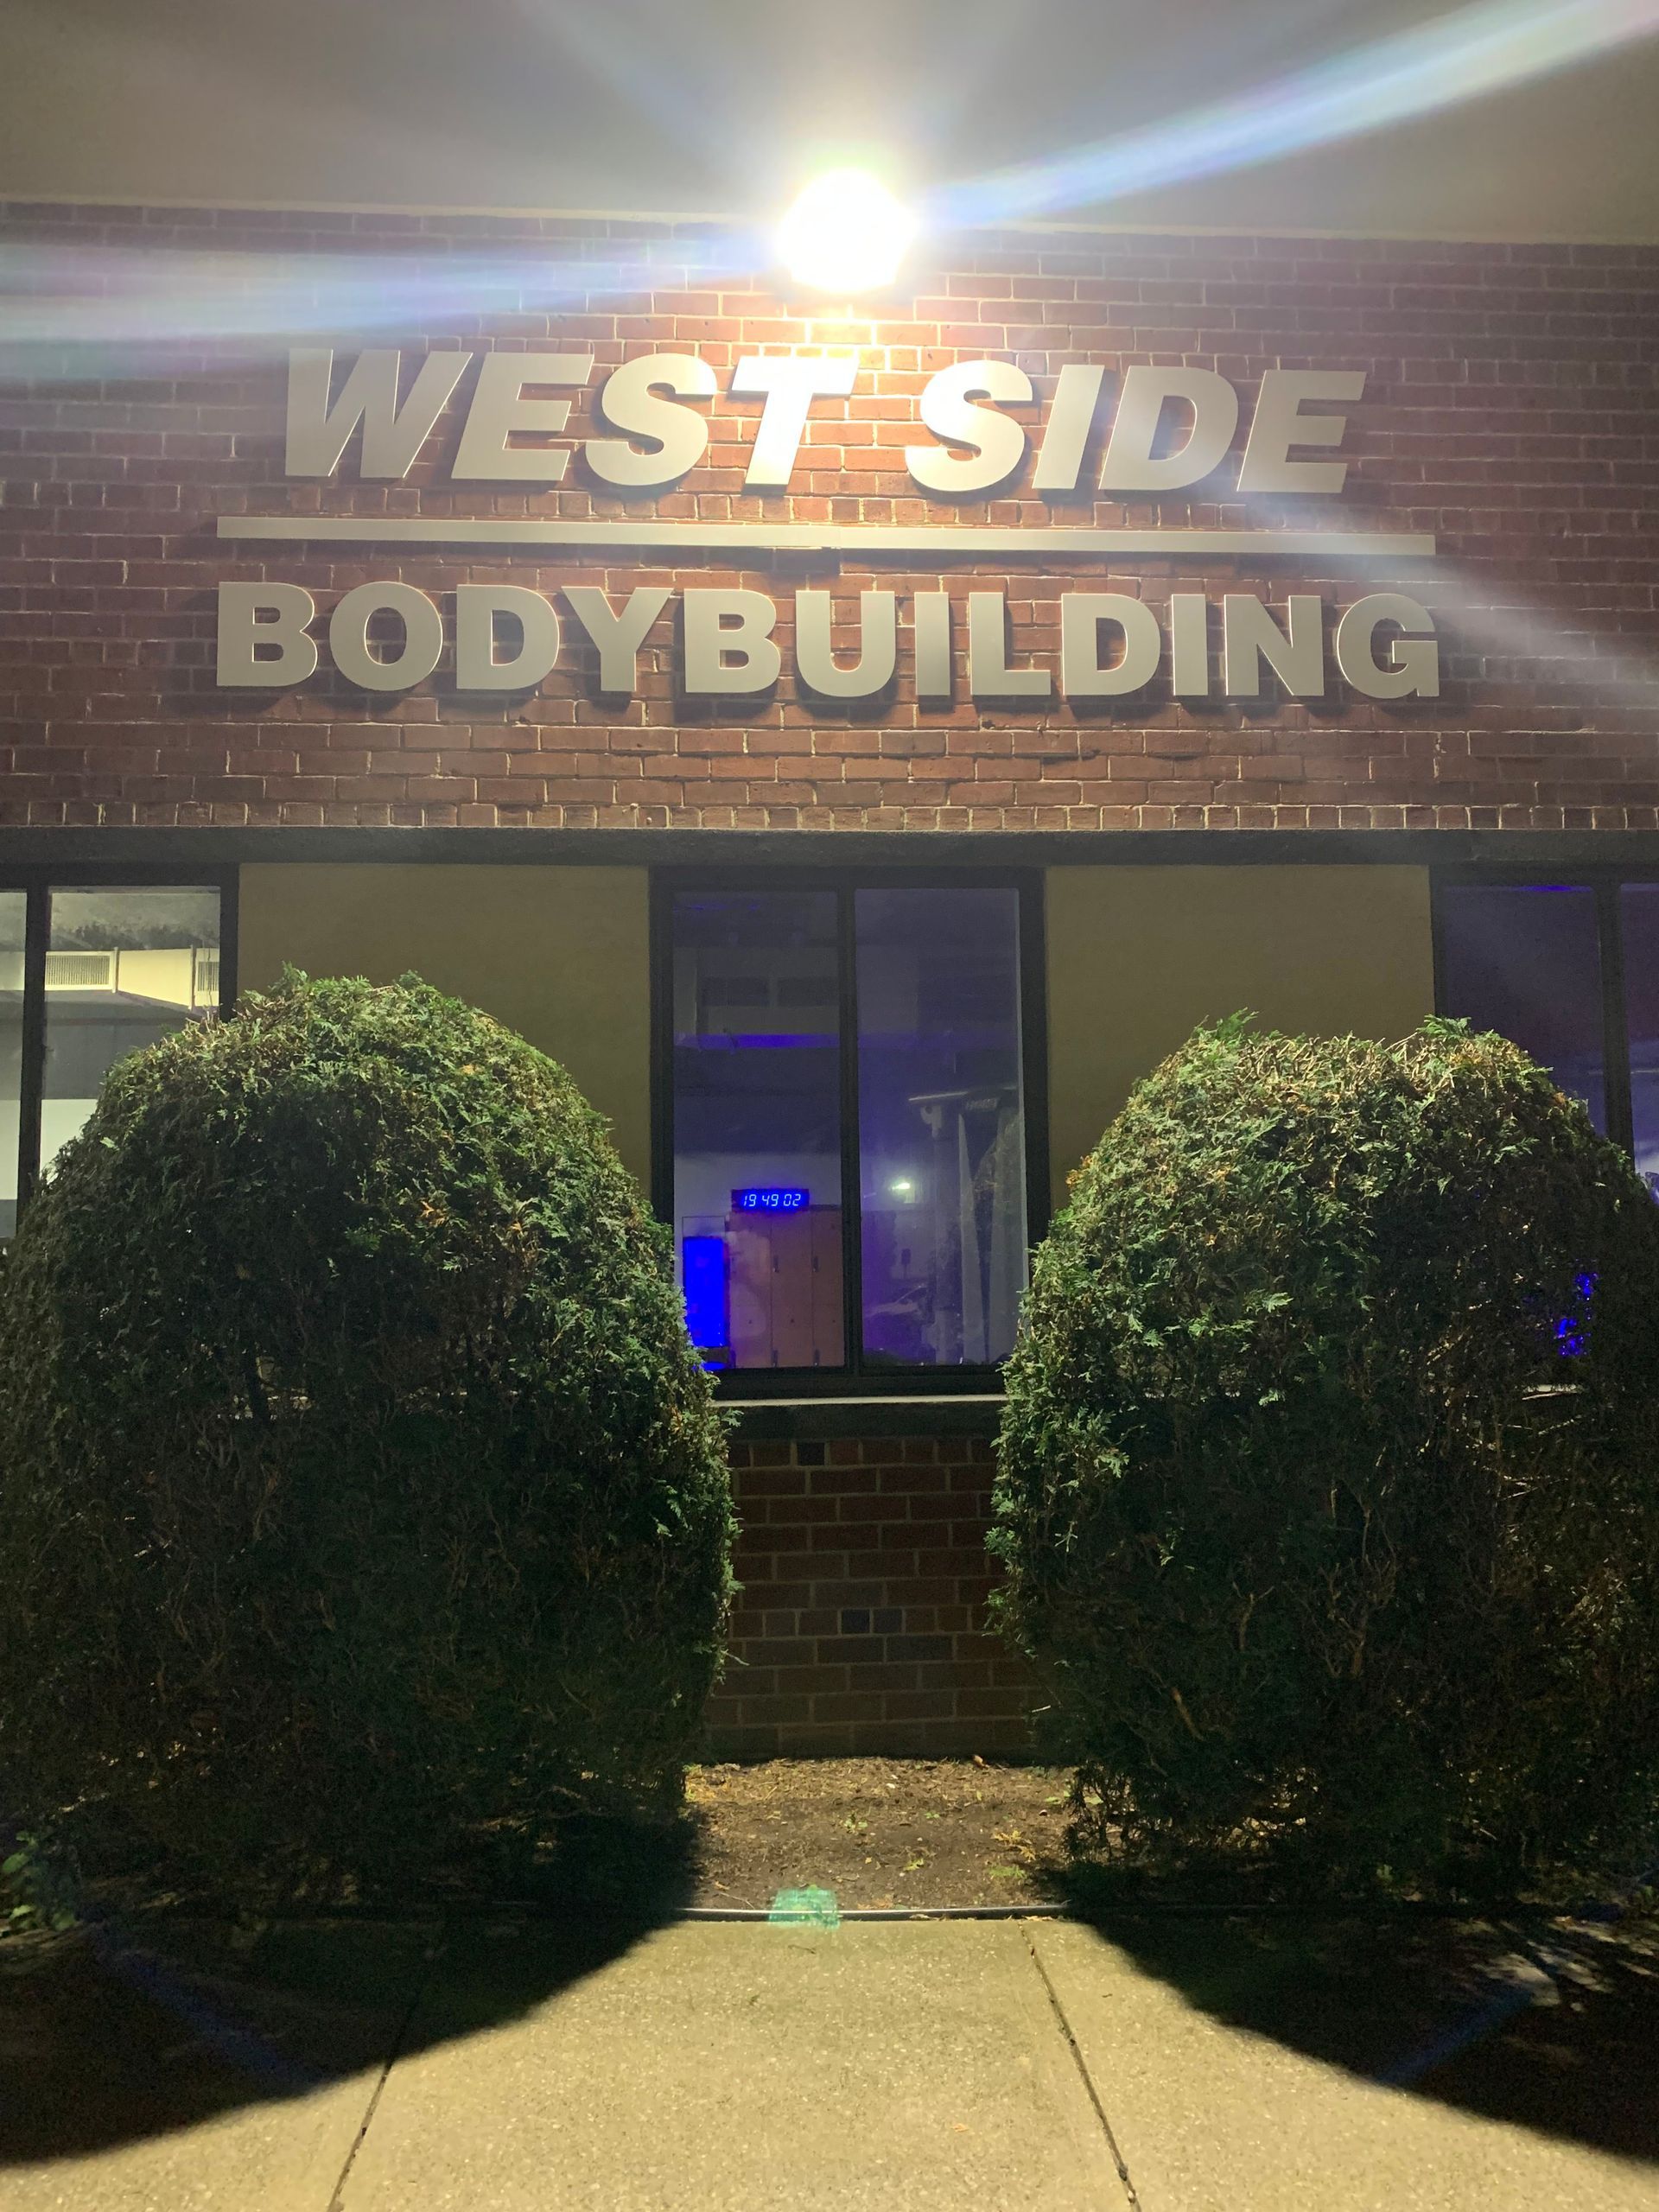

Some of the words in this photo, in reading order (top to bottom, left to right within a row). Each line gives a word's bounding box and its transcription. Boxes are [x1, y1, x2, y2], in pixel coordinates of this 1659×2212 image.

[284, 348, 859, 486] WEST
[905, 359, 1367, 494] SIDE
[216, 581, 1440, 700] BODYBUILDING
